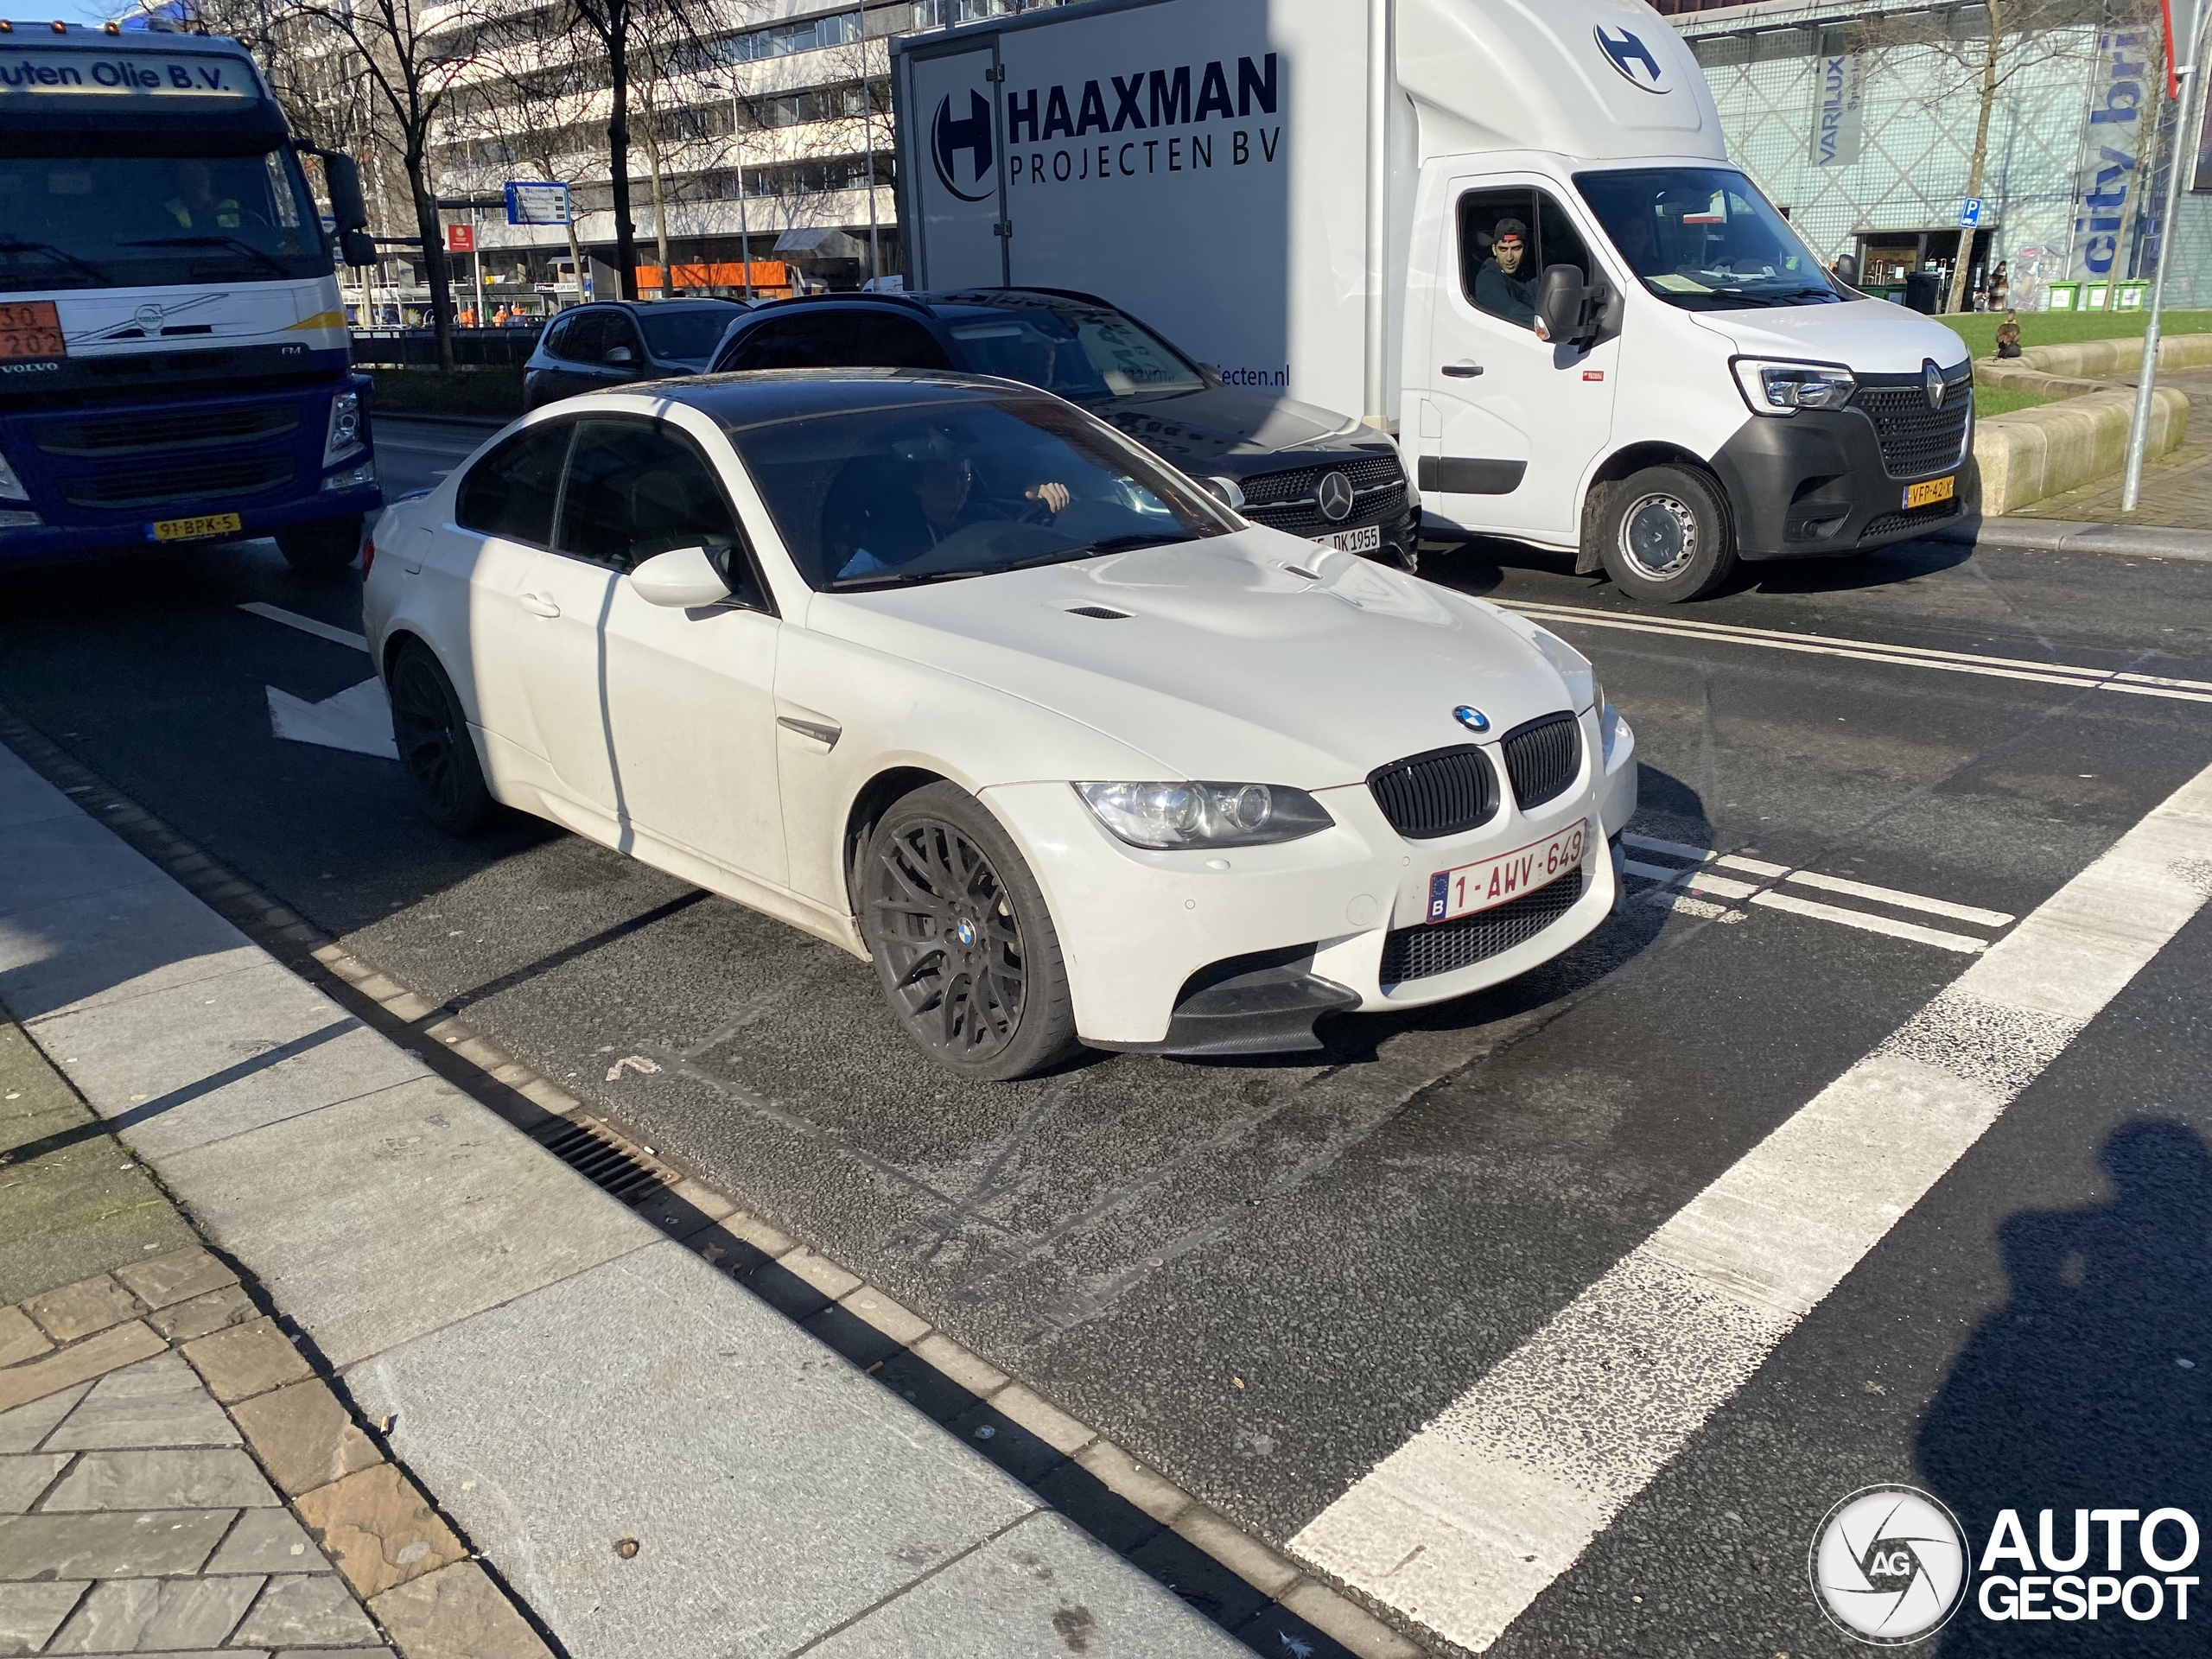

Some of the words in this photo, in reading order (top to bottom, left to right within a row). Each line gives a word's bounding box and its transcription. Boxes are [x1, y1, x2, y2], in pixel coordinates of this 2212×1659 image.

[0, 60, 82, 86] uten
[92, 61, 161, 87] Olie
[167, 64, 231, 91] B.V.
[1007, 53, 1277, 143] HAAXMAN
[1819, 56, 1846, 165] VARILUX
[1010, 134, 1213, 186] PROJECTEN
[1233, 126, 1281, 166] BV
[1967, 200, 1978, 216] P
[2075, 145, 2136, 273] city
[282, 346, 301, 355] FM
[0, 362, 59, 373] VOLVO
[1217, 365, 1290, 386] ecten.nl
[1912, 480, 1952, 503] VFP-42-X
[1455, 830, 1582, 908] 1-AWV-649
[1432, 899, 1444, 916] B
